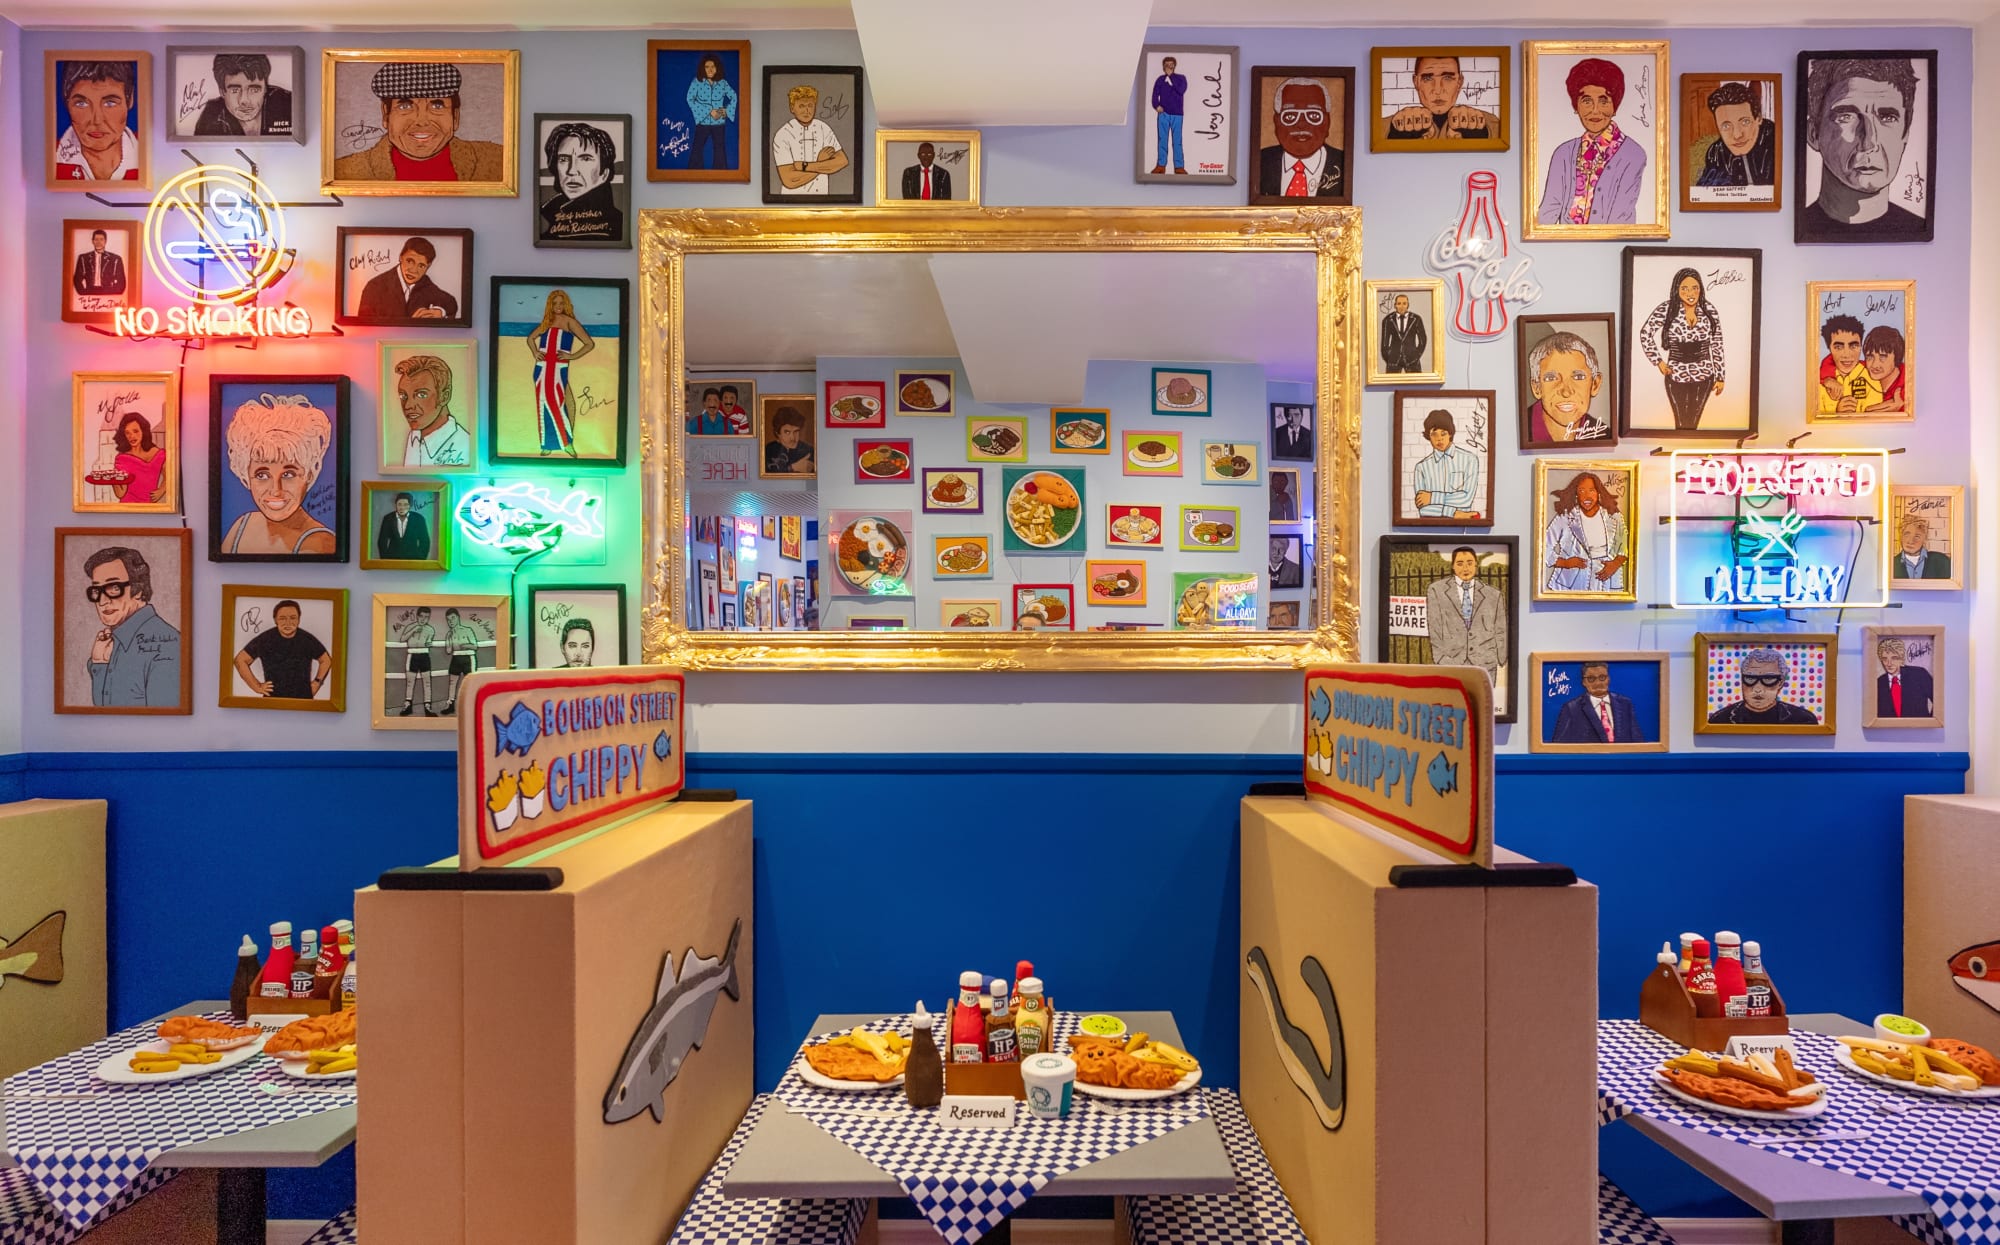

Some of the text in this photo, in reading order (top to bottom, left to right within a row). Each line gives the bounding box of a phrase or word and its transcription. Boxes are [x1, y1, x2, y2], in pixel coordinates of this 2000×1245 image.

[1452, 115, 1485, 124] FAST
[1429, 226, 1498, 271] Coca
[1469, 257, 1542, 303] Cola
[114, 306, 310, 337] NO SMOKING
[1683, 459, 1877, 497] FOOD SERVED
[1712, 565, 1845, 603] ALL DAY
[542, 692, 677, 737] BOURDON STREET
[1333, 689, 1467, 750] BOURDON STREET
[547, 744, 648, 812] CHIPPY
[1335, 734, 1420, 807] CHIPPY
[293, 980, 313, 991] HP
[1752, 995, 1770, 1007] HP
[994, 1038, 1014, 1053] HP
[995, 1053, 1015, 1062] SAUCE
[949, 1105, 1006, 1120] Reserved
